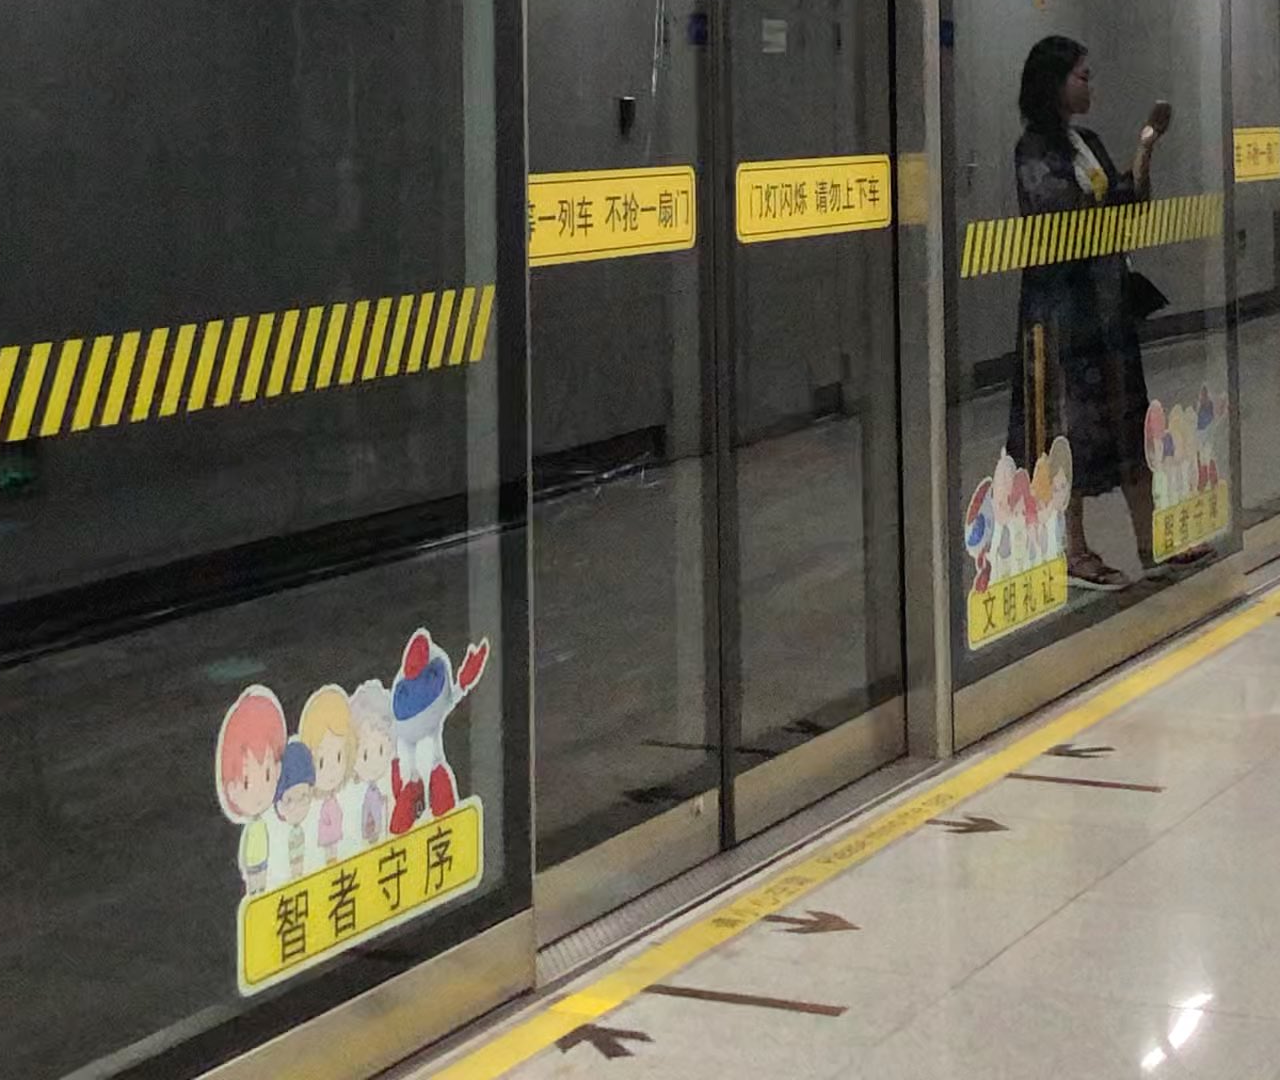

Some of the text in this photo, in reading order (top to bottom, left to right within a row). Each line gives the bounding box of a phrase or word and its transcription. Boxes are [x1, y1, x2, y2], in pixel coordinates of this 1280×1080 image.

[604, 190, 690, 233] 不抢一扇门
[749, 175, 881, 220] 门灯闪烁 请勿上下车
[982, 567, 1056, 634] 文明礼让
[275, 825, 454, 963] 智者守序
